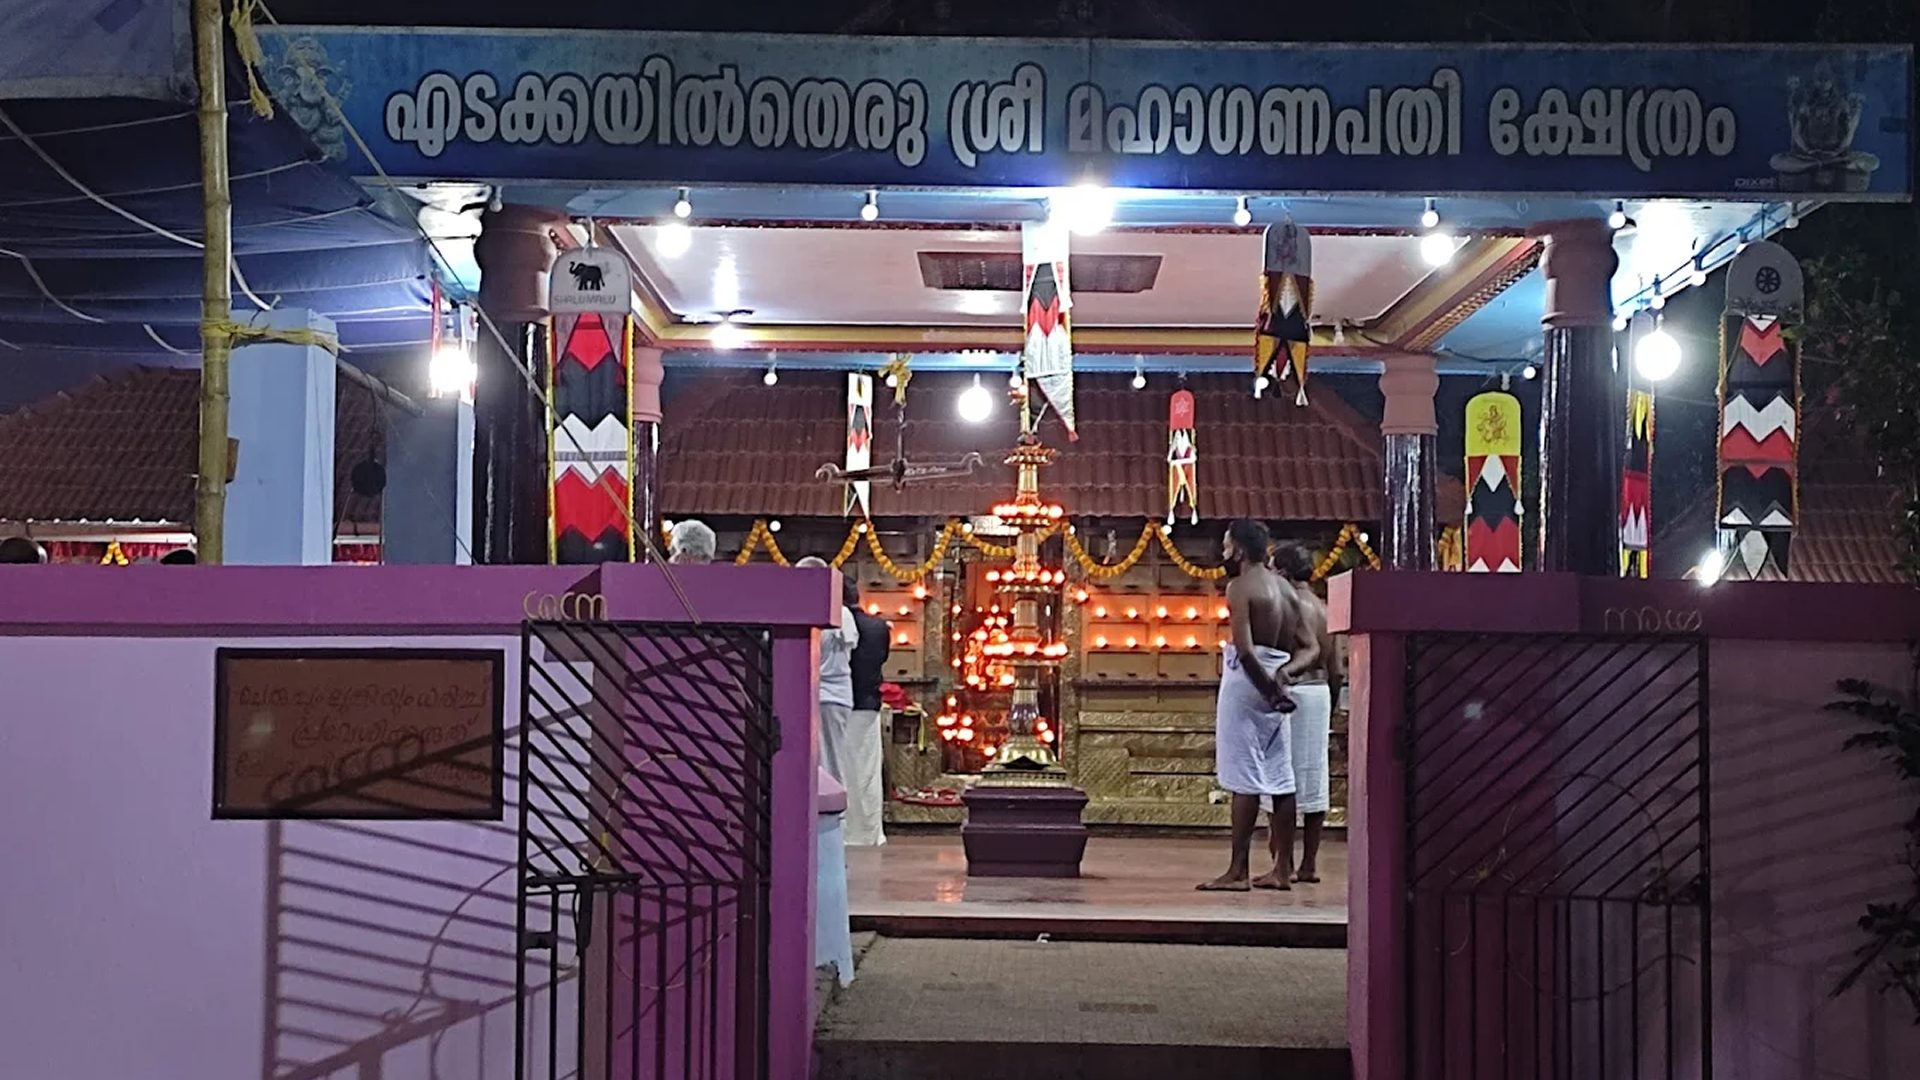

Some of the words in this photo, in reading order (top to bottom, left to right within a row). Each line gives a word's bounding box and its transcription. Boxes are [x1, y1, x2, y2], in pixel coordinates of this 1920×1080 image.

[384, 55, 928, 168] എടക്കയിൽതെരു
[948, 62, 1048, 168] ശ്രീ
[1067, 67, 1464, 156] മഹാഗണപതി
[1488, 87, 1738, 172] ക്ഷേത്രം
